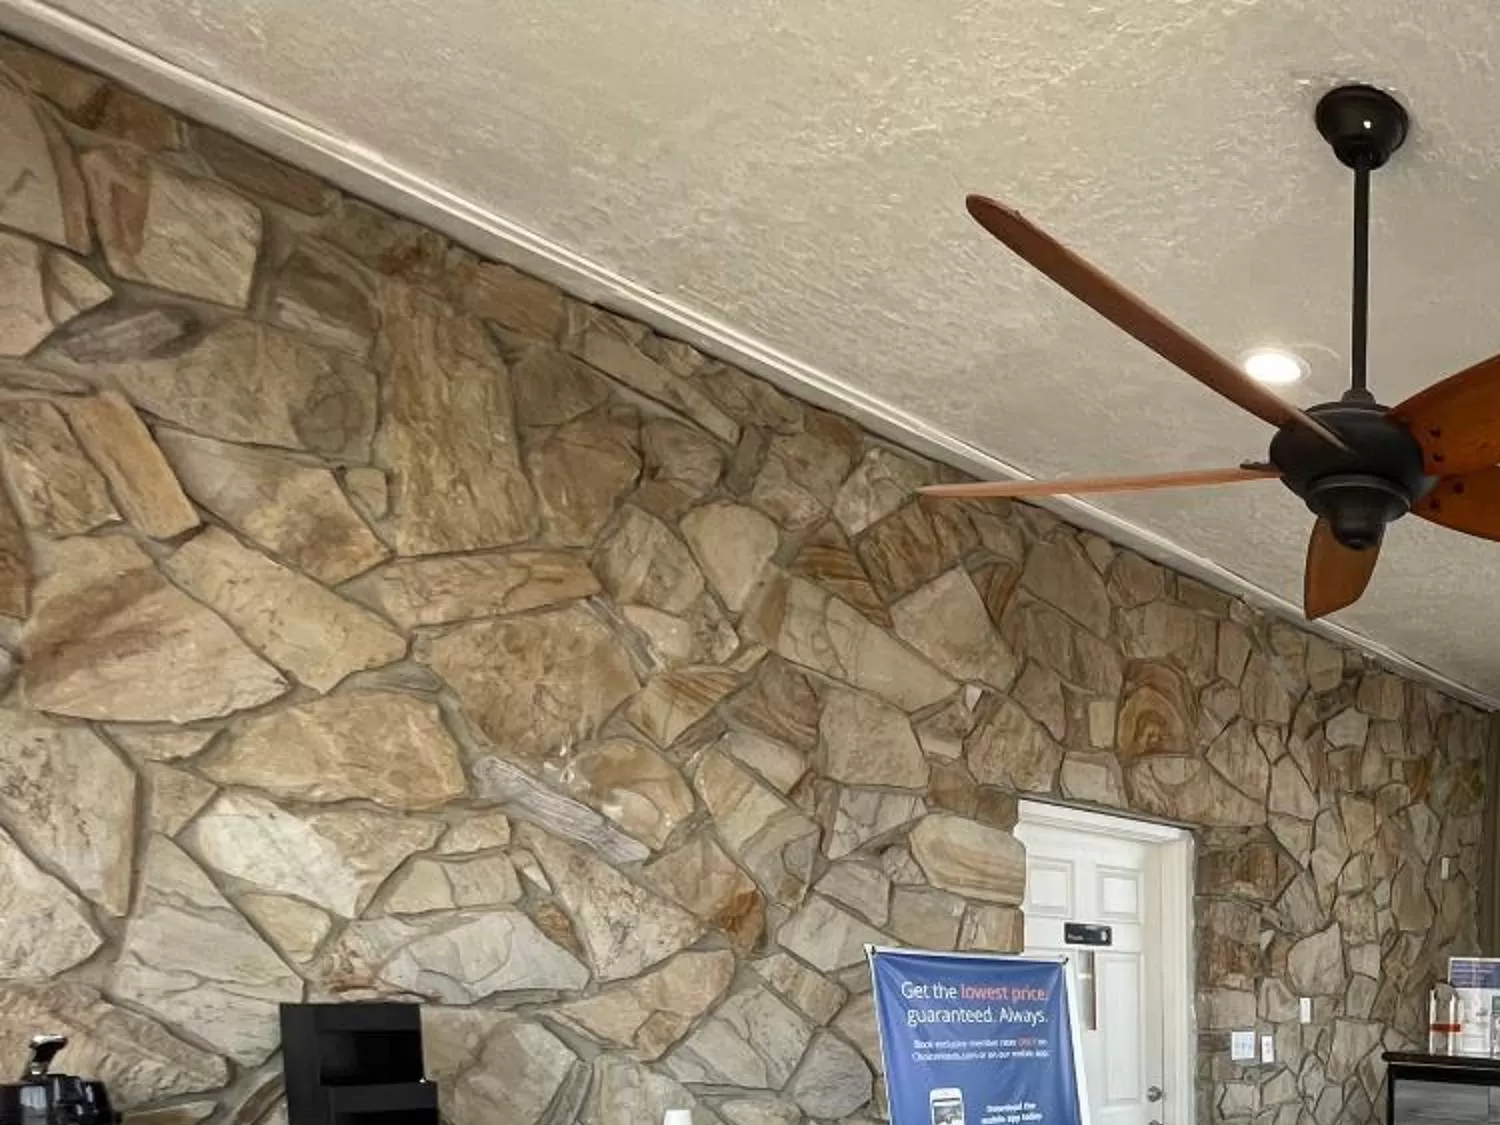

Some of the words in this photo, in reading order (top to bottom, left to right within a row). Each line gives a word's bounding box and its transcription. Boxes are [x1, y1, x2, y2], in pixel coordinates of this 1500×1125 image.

[901, 981, 928, 999] Get
[933, 982, 959, 1000] the
[960, 983, 1009, 1000] lowest
[907, 1007, 997, 1026] guaranteed.
[1000, 1007, 1048, 1027] Always.
